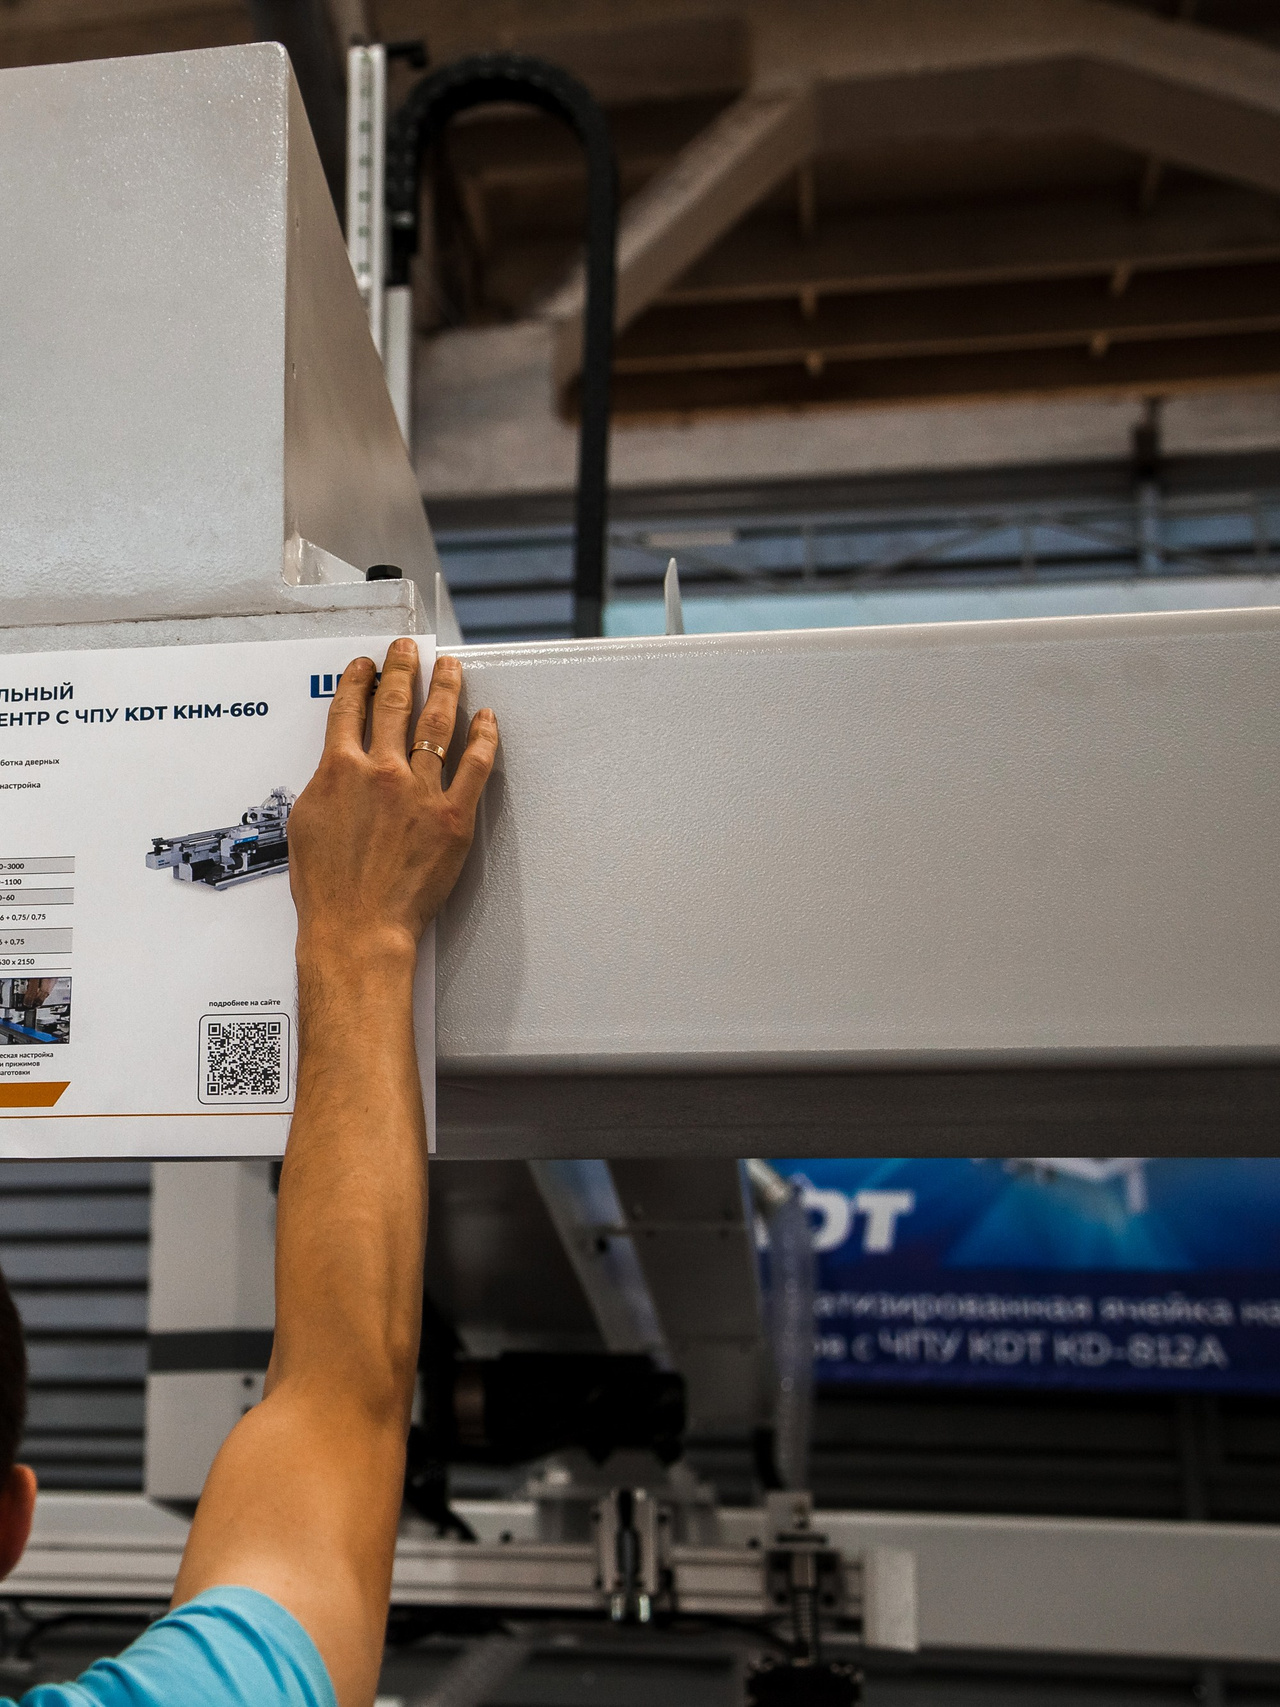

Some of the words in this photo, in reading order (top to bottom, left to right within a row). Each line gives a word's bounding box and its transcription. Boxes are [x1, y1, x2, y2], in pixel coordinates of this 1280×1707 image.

[56, 709, 70, 725] С
[75, 708, 120, 724] ЧПУ
[125, 705, 169, 722] KDT
[173, 701, 270, 720] KHM-660
[24, 758, 60, 767] дверных
[0, 782, 41, 790] настройка
[17, 958, 35, 966] 2150
[208, 1000, 249, 1008] подробнее
[19, 1052, 54, 1060] настройка
[5, 1060, 40, 1069] прижимов
[756, 1188, 917, 1254] DT
